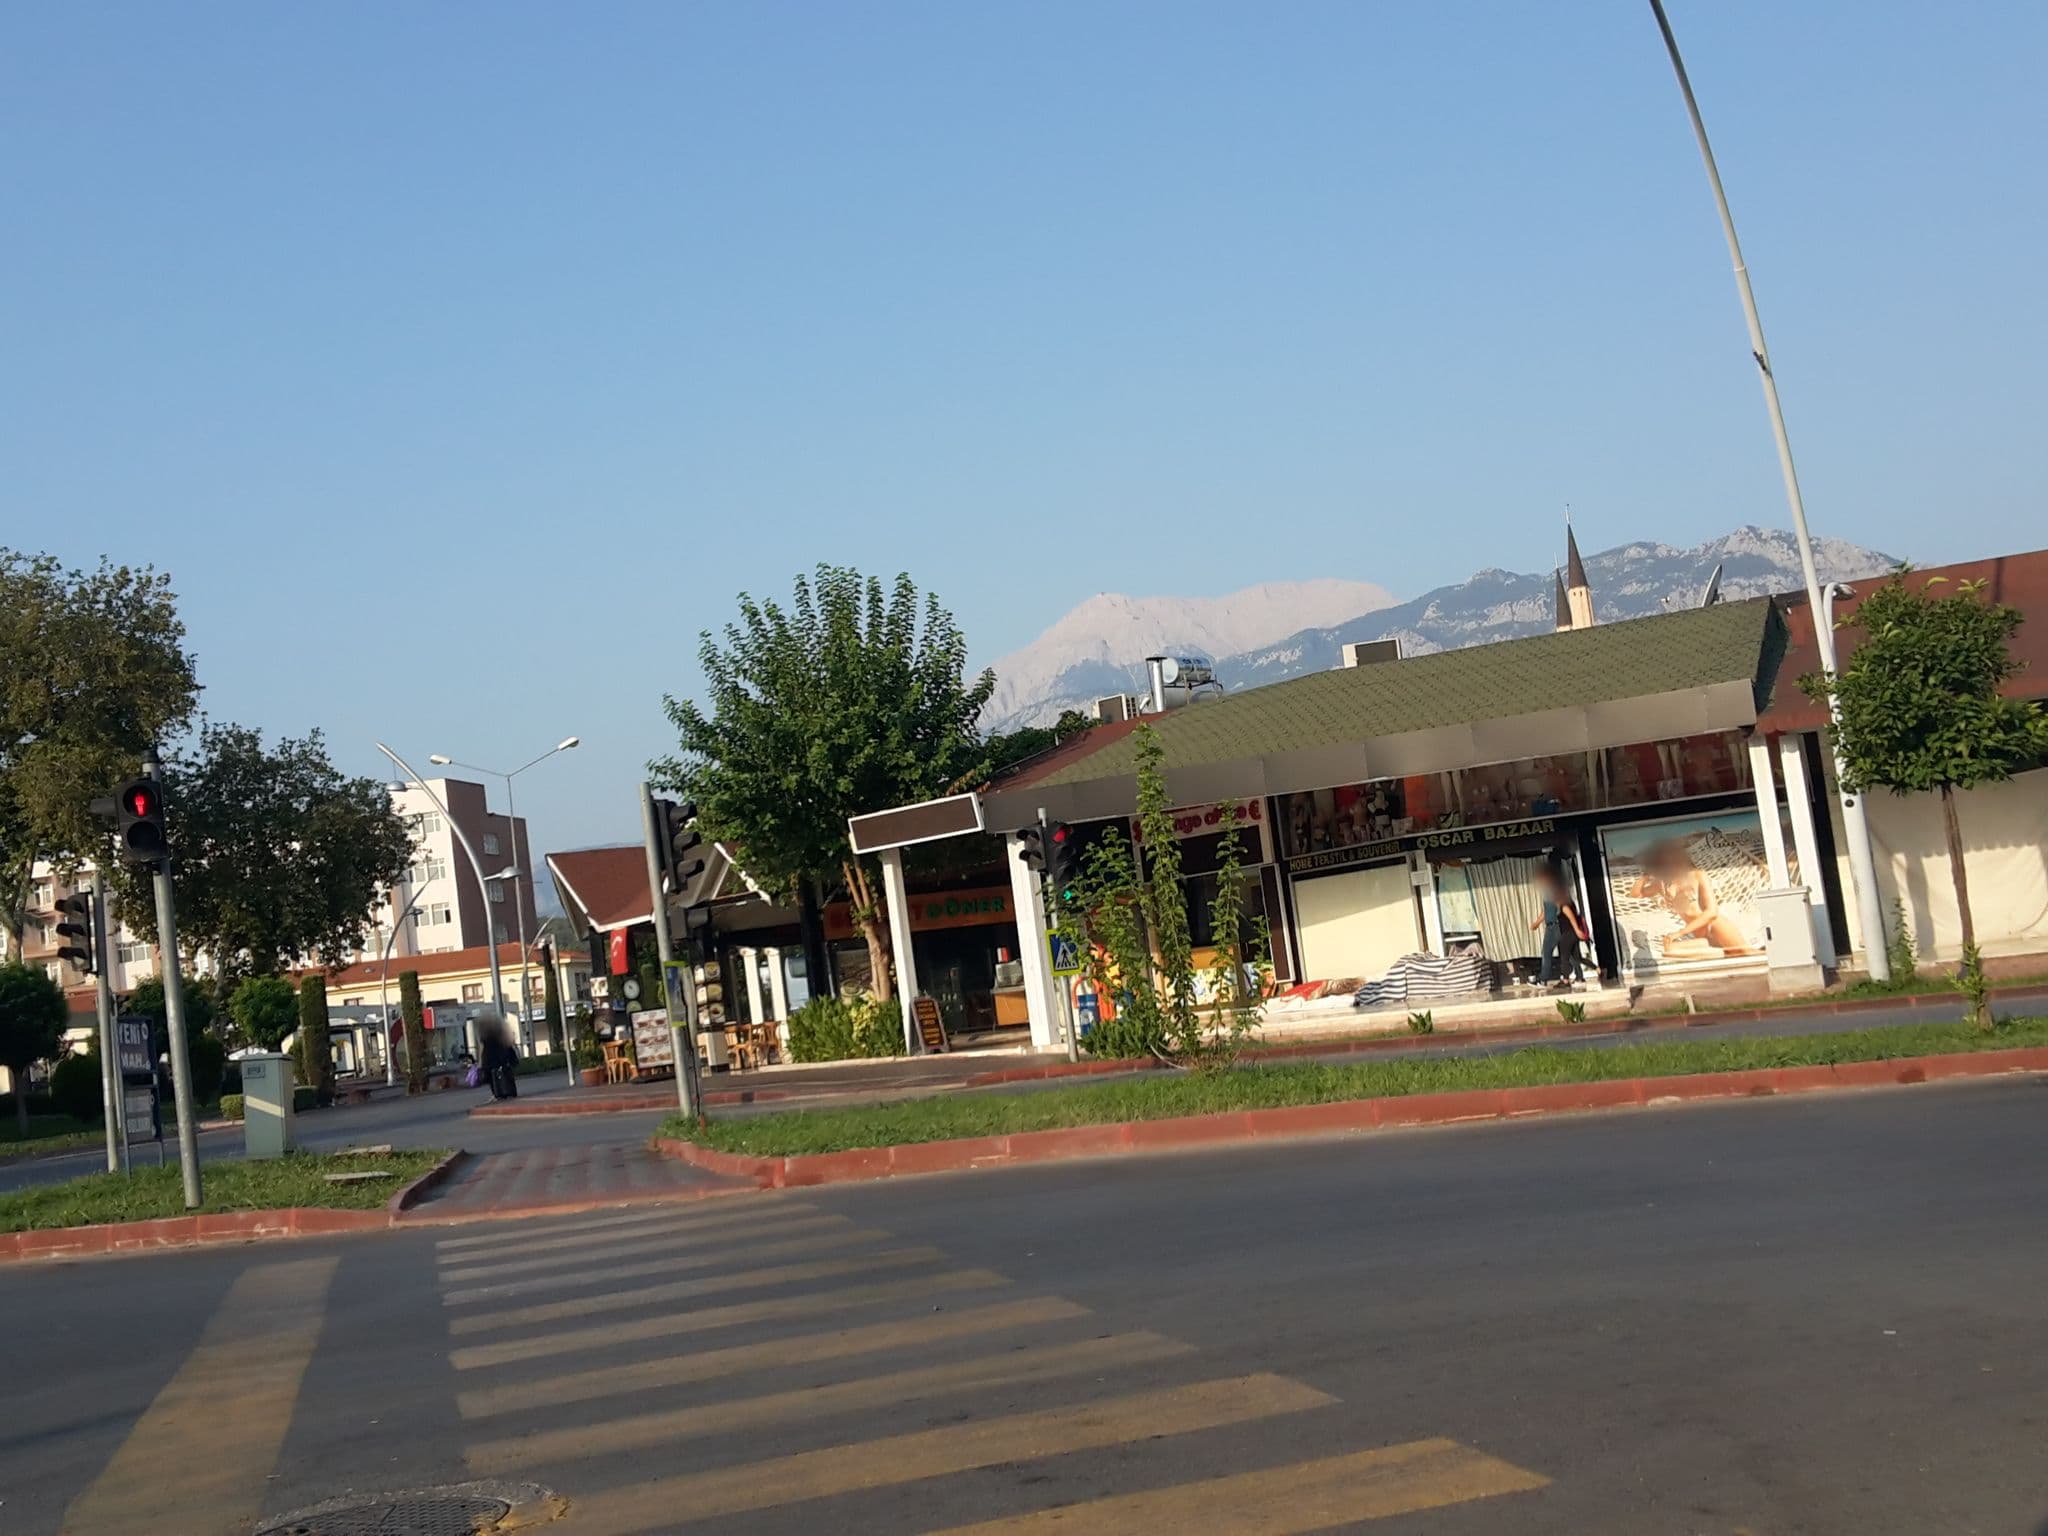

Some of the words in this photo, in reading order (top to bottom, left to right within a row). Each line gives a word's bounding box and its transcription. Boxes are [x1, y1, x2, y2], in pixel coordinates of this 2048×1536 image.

[1417, 831, 1474, 849] OSCAR
[1484, 820, 1555, 840] BAZAAR
[927, 896, 1006, 920] DÖNER
